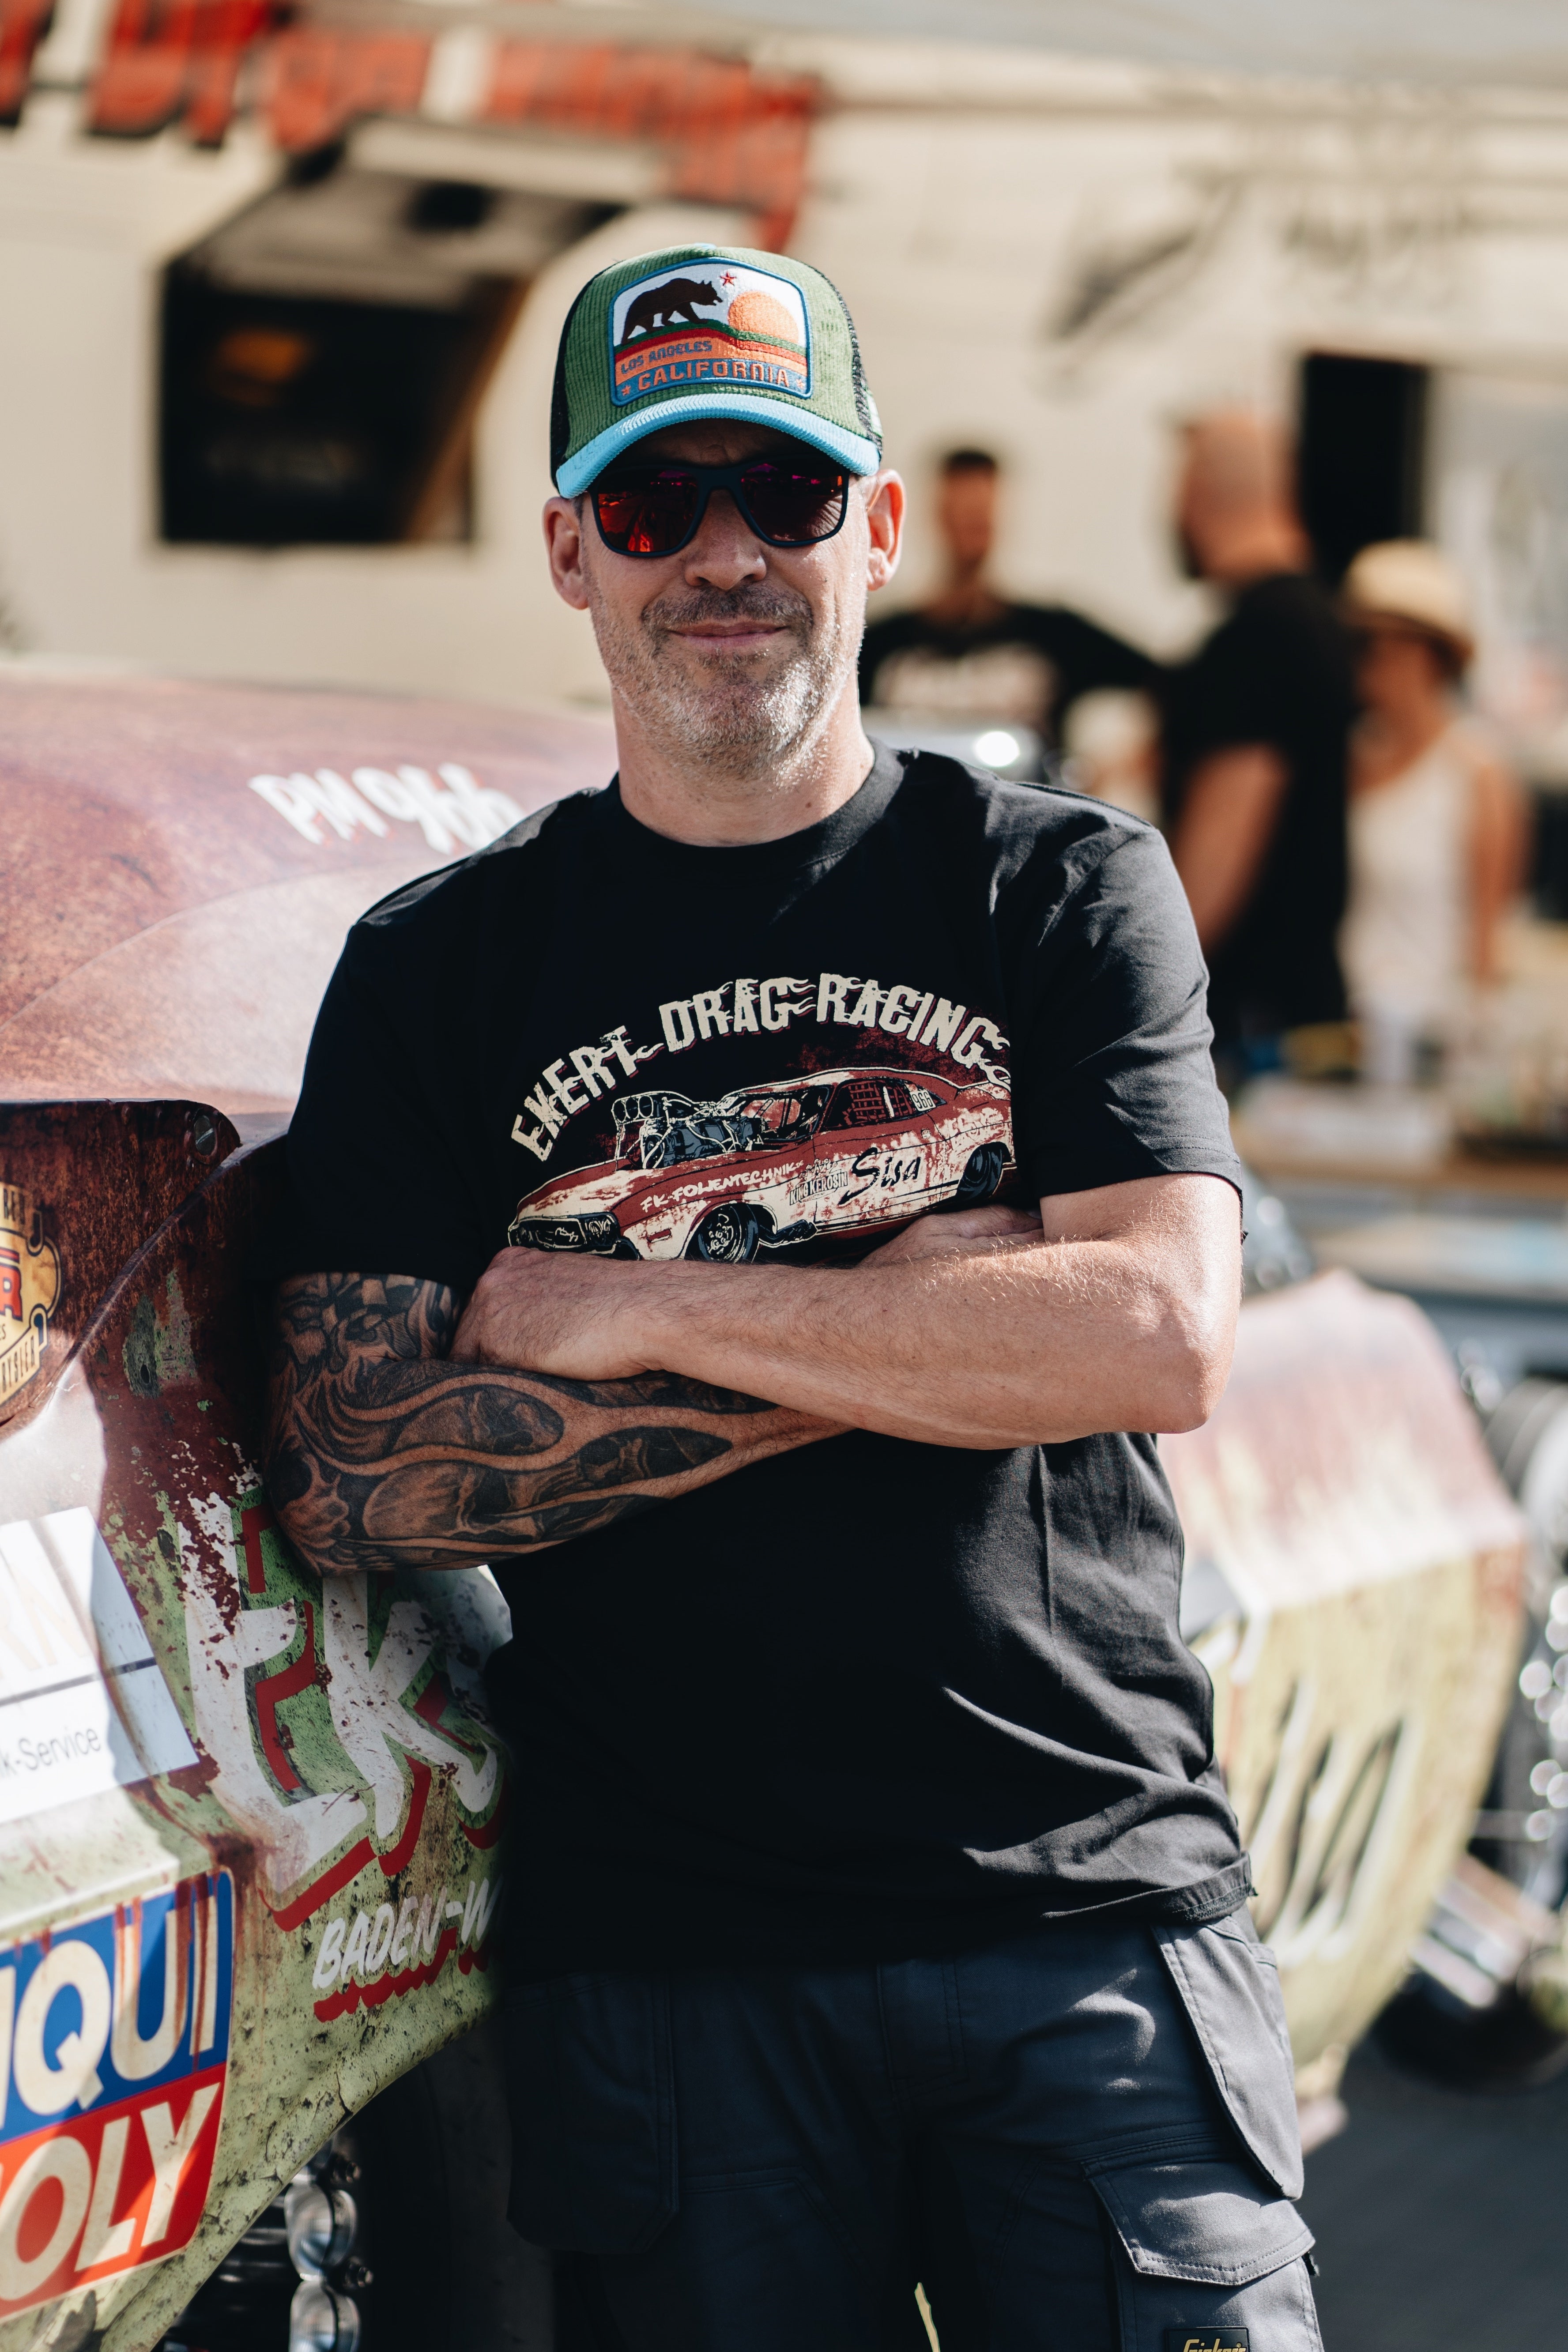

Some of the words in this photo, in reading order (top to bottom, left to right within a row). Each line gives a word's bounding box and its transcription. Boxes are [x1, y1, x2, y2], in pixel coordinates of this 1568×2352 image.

[622, 354, 644, 374] LOS
[648, 340, 712, 363] ANGELES
[638, 361, 790, 392] CALIFORNIA
[511, 1025, 663, 1162] EKERT
[659, 977, 817, 1052] DRAG
[817, 972, 1010, 1070] RACING
[911, 1091, 933, 1109] 966
[789, 1183, 809, 1206] KING
[809, 1171, 848, 1195] KEROSIN
[177, 1446, 508, 1895] EK
[312, 1875, 505, 1989] BADEN-W
[0, 2082, 221, 2301] OLY
